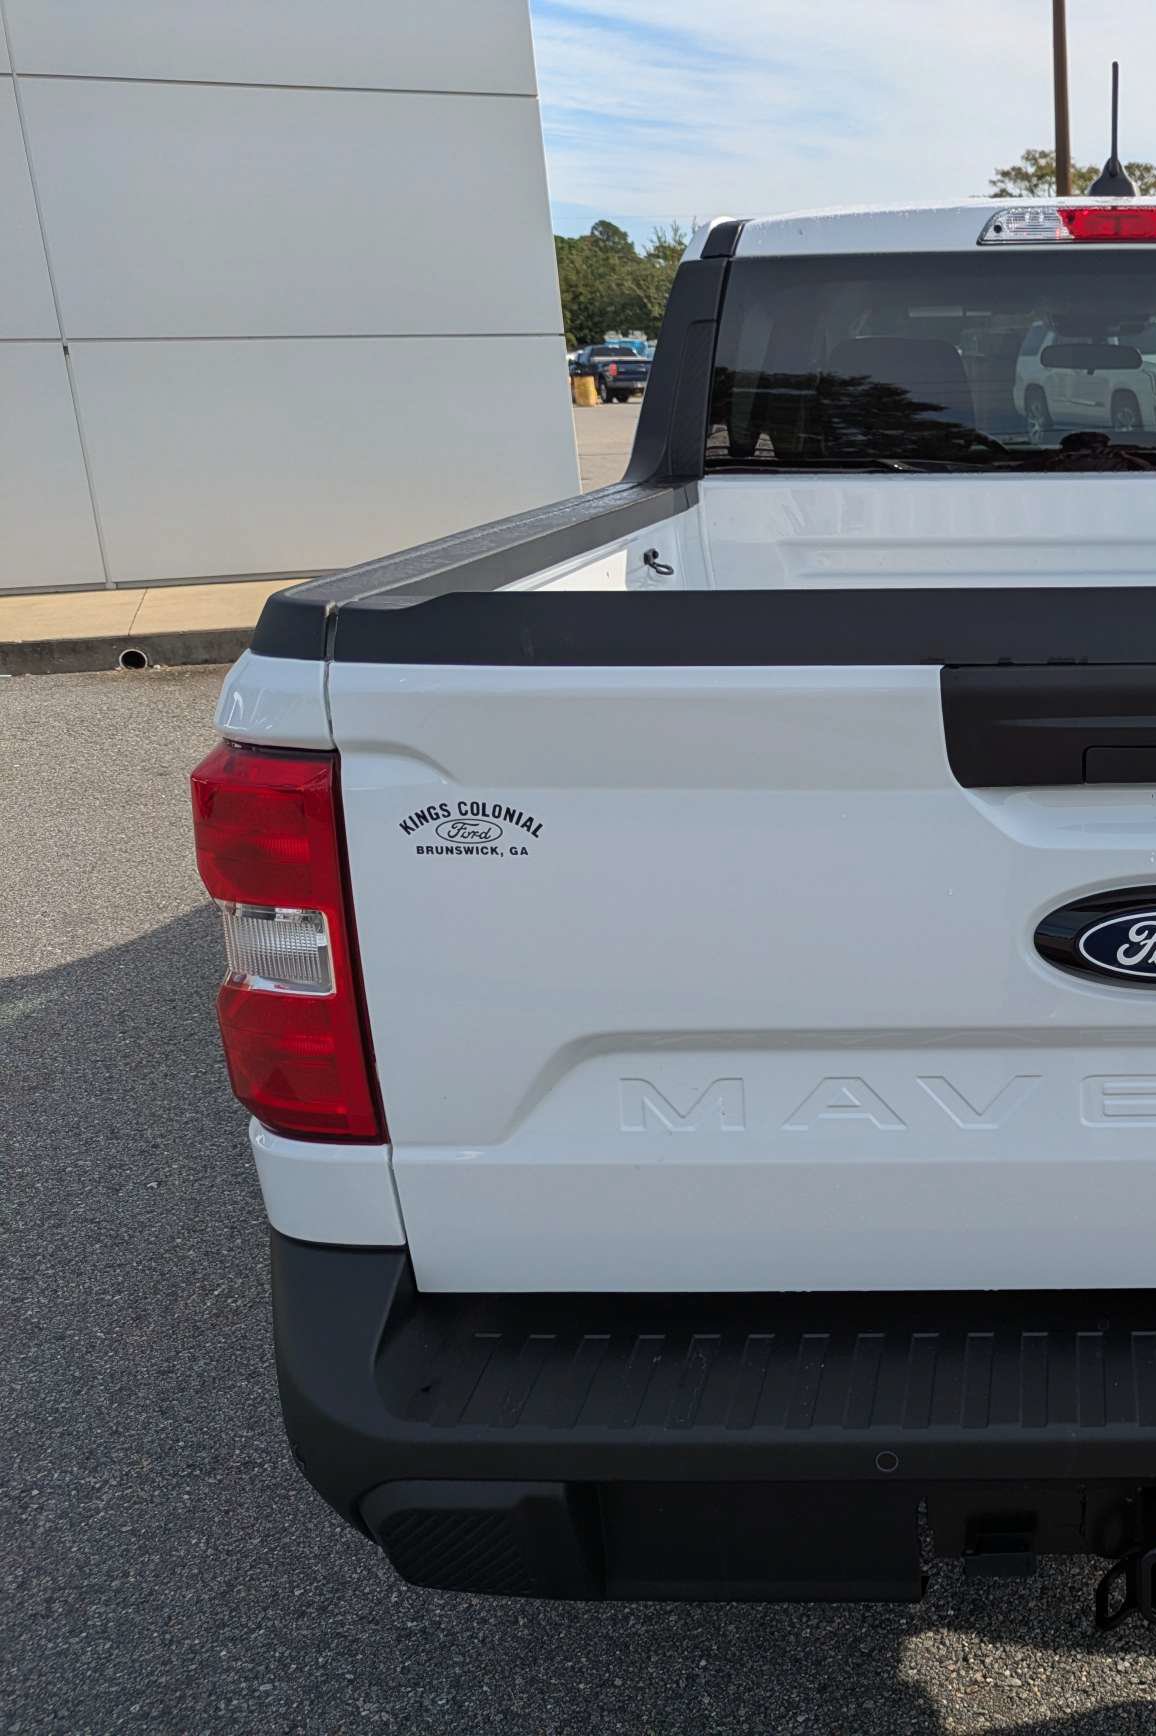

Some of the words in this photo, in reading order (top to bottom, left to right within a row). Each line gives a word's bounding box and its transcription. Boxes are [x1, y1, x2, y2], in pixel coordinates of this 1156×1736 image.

[399, 803, 451, 835] KINGS
[458, 801, 543, 838] COLONIAL
[447, 822, 492, 840] Ford
[416, 845, 504, 857] BRUNSWICK,
[509, 846, 529, 856] GA
